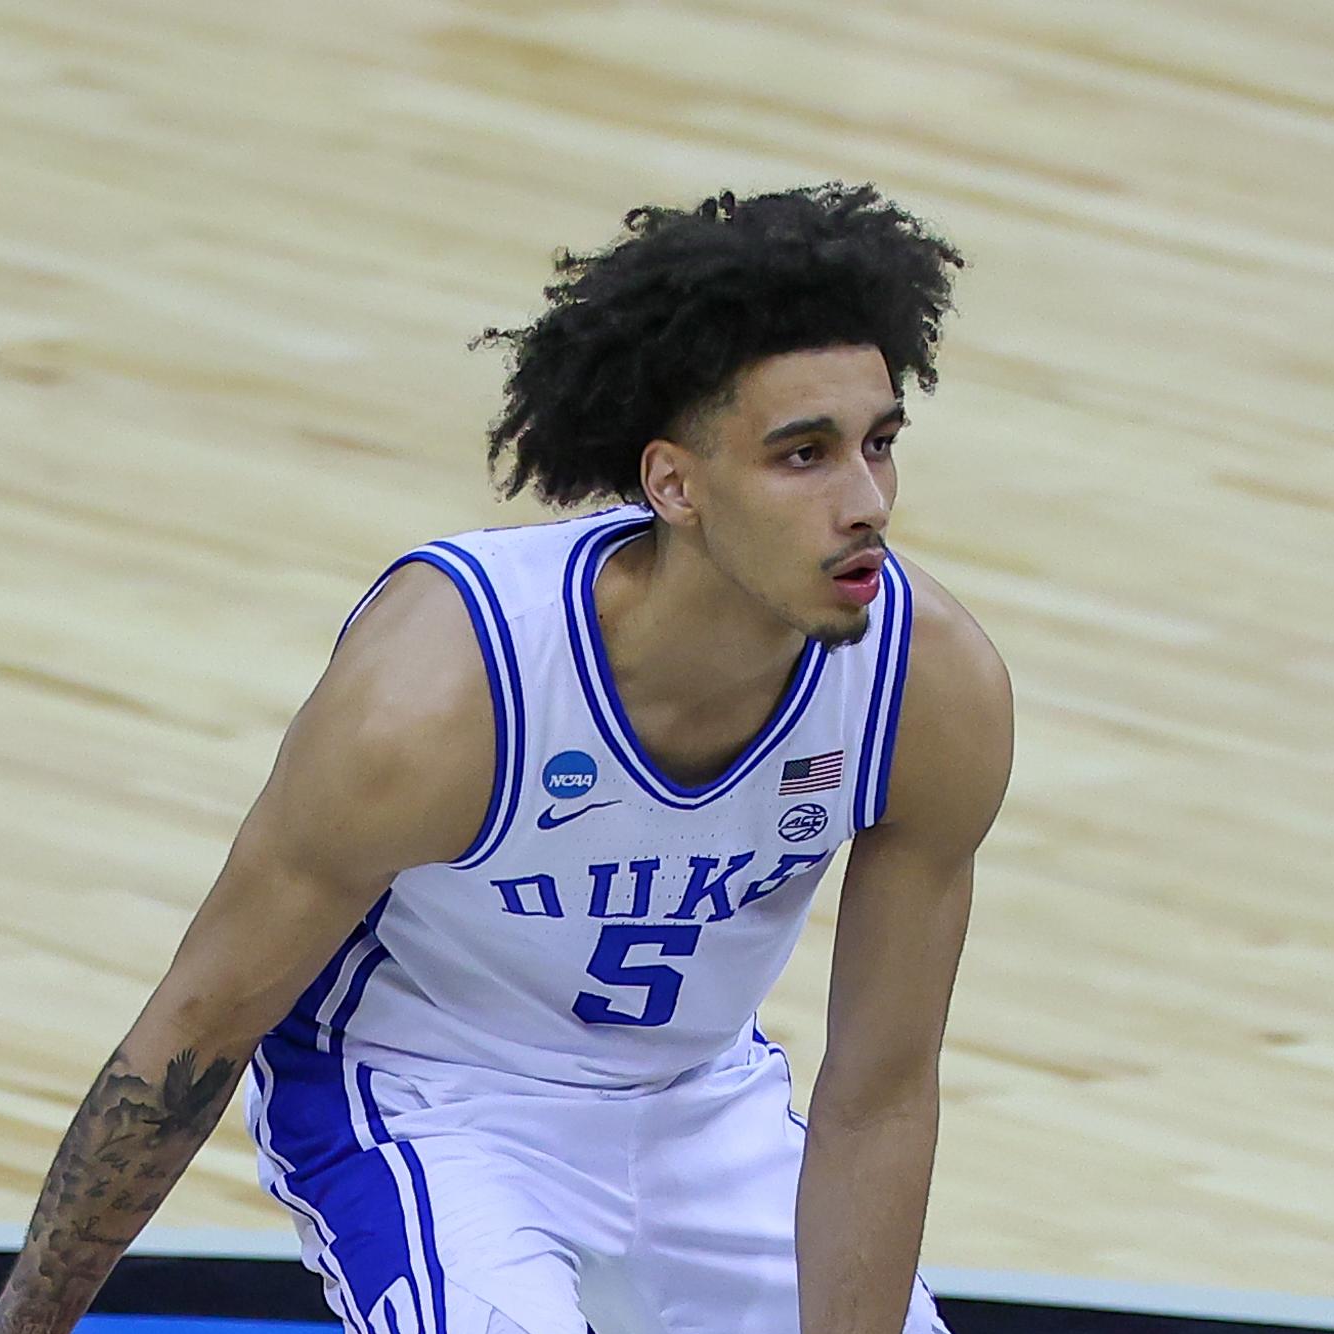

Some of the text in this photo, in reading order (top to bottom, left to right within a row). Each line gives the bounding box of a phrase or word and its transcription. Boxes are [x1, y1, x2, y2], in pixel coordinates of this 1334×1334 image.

[549, 774, 593, 788] NCAA
[490, 850, 829, 923] DUKE
[572, 924, 702, 1026] 5
